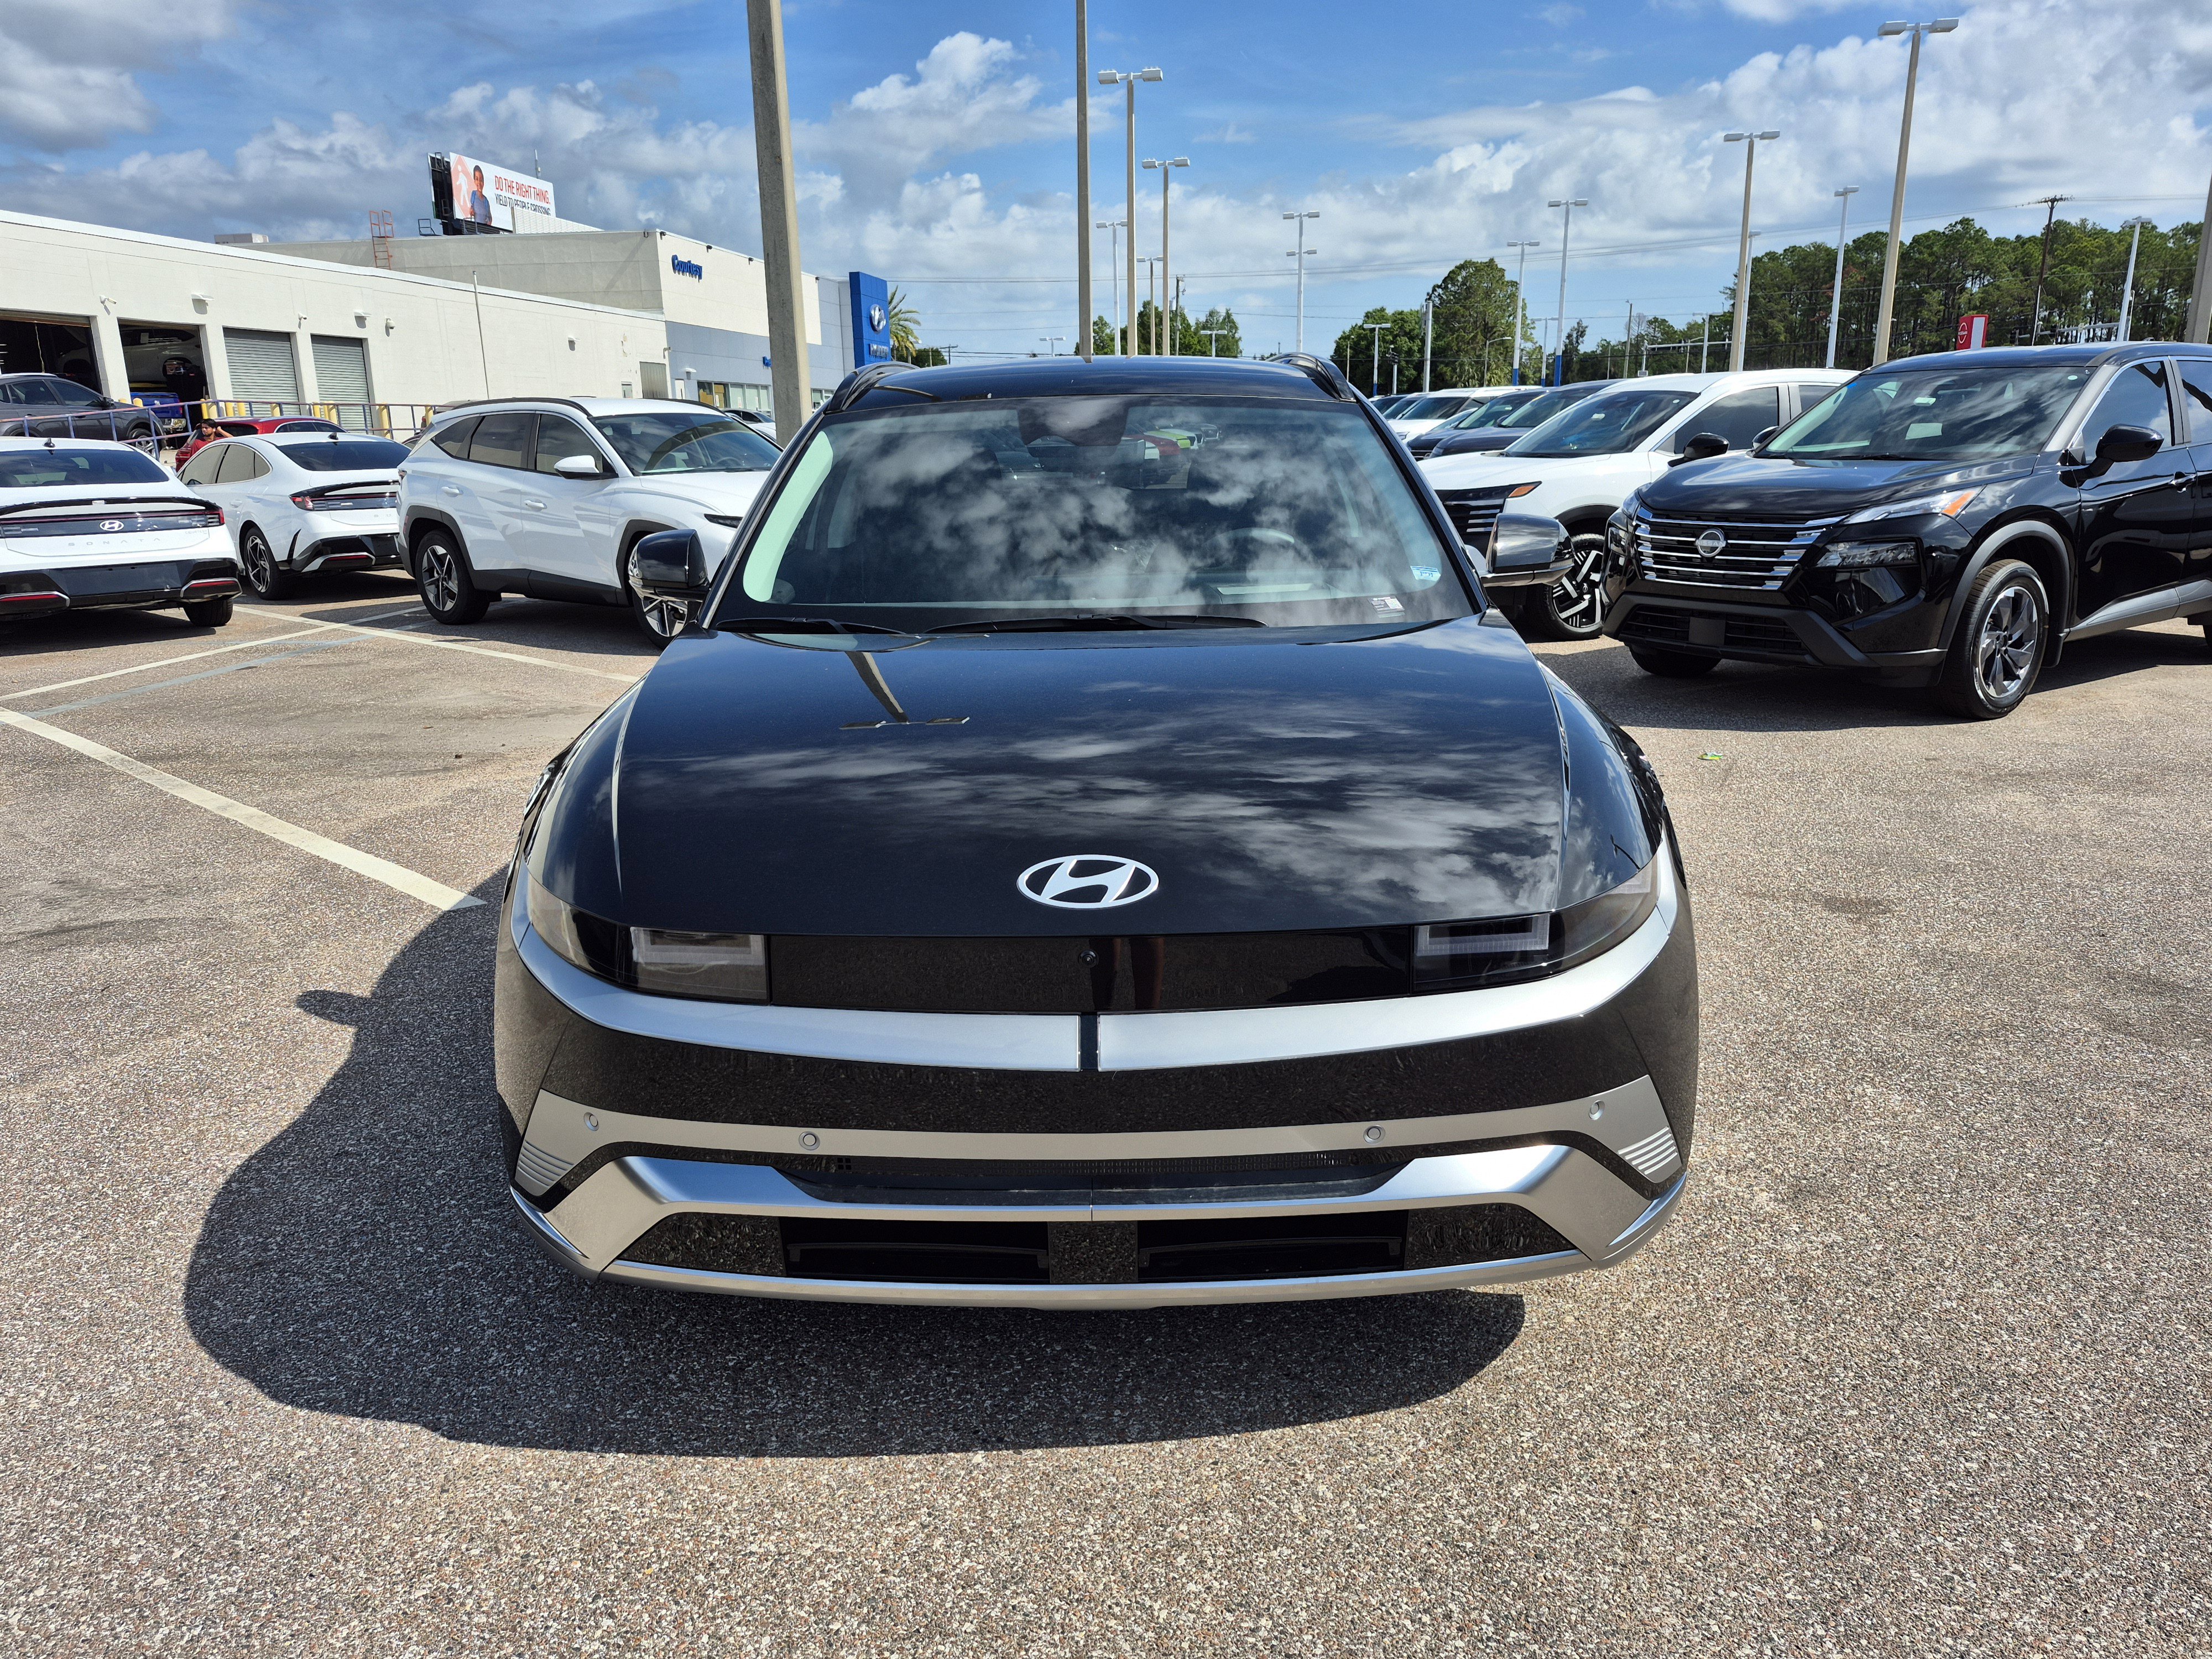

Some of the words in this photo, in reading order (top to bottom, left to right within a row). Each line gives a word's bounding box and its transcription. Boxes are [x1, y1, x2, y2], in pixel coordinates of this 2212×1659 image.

[495, 175, 503, 191] DO
[504, 178, 515, 195] THE
[515, 181, 532, 199] RIGHT
[494, 193, 508, 207] YIELD
[508, 196, 514, 208] TO
[671, 254, 703, 280] Courtesy
[67, 538, 161, 547] SONATA
